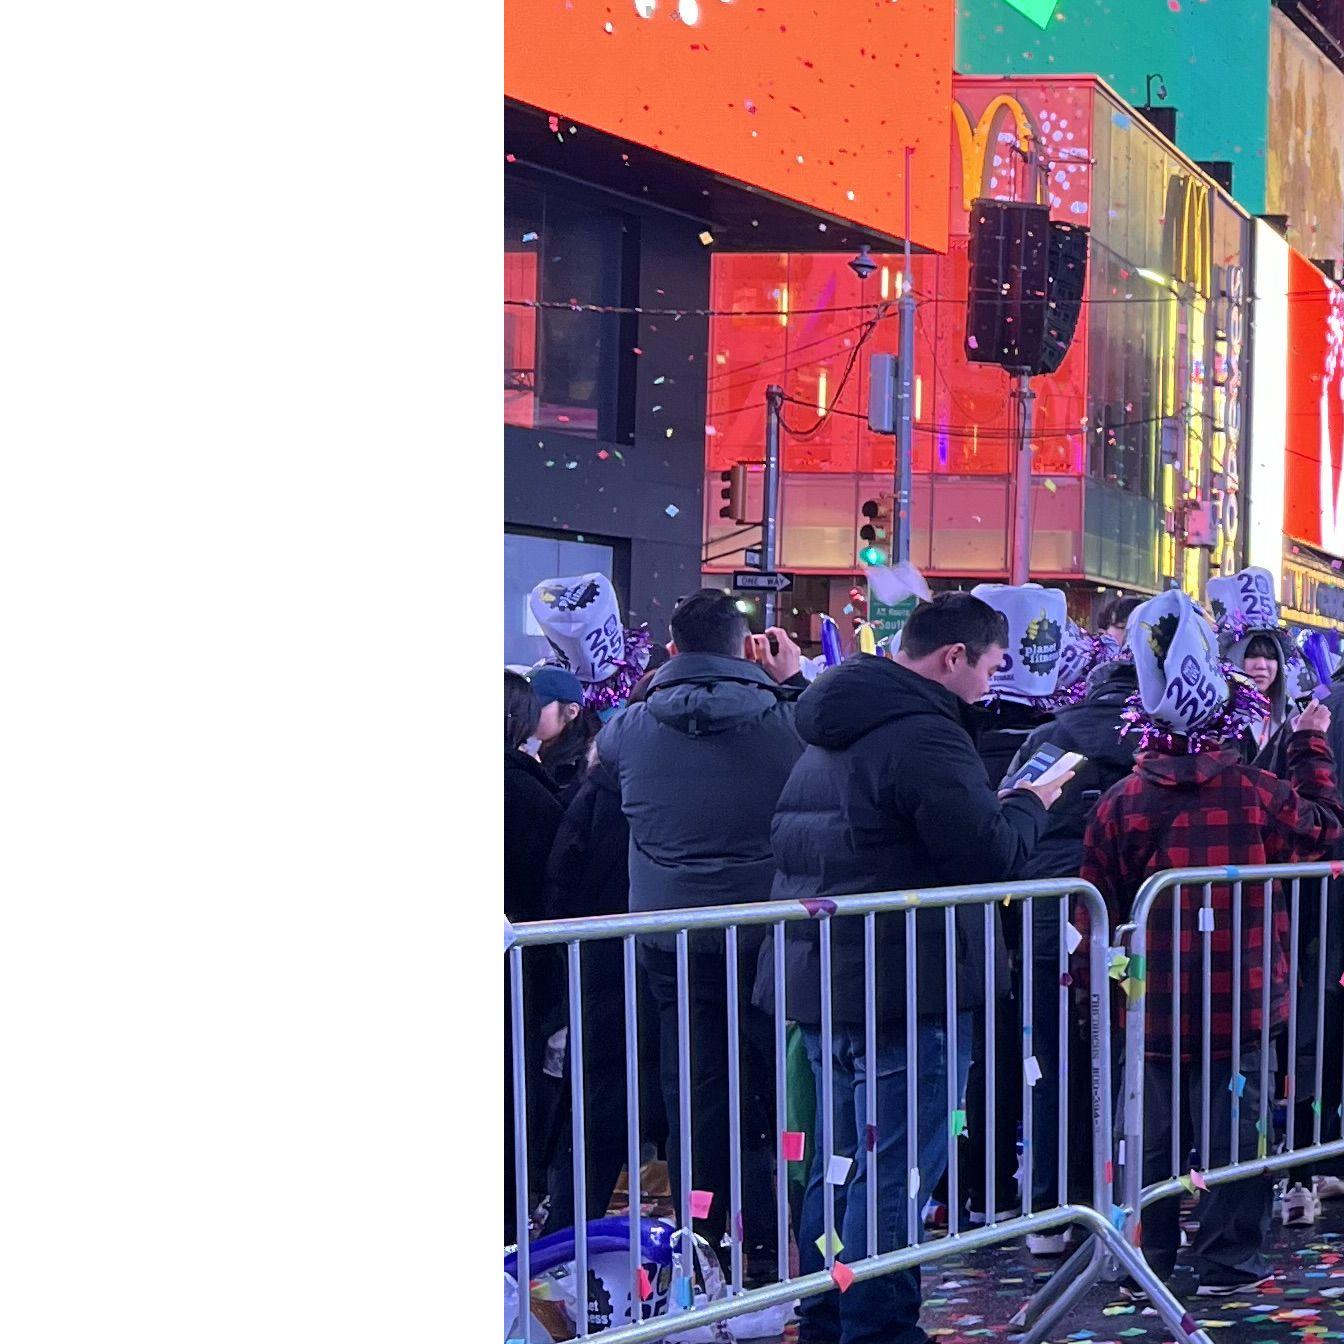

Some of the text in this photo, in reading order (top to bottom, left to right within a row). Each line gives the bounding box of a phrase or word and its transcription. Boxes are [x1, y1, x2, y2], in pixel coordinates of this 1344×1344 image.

[767, 577, 784, 586] WAY
[1237, 573, 1270, 595] 20
[1242, 595, 1273, 616] 25
